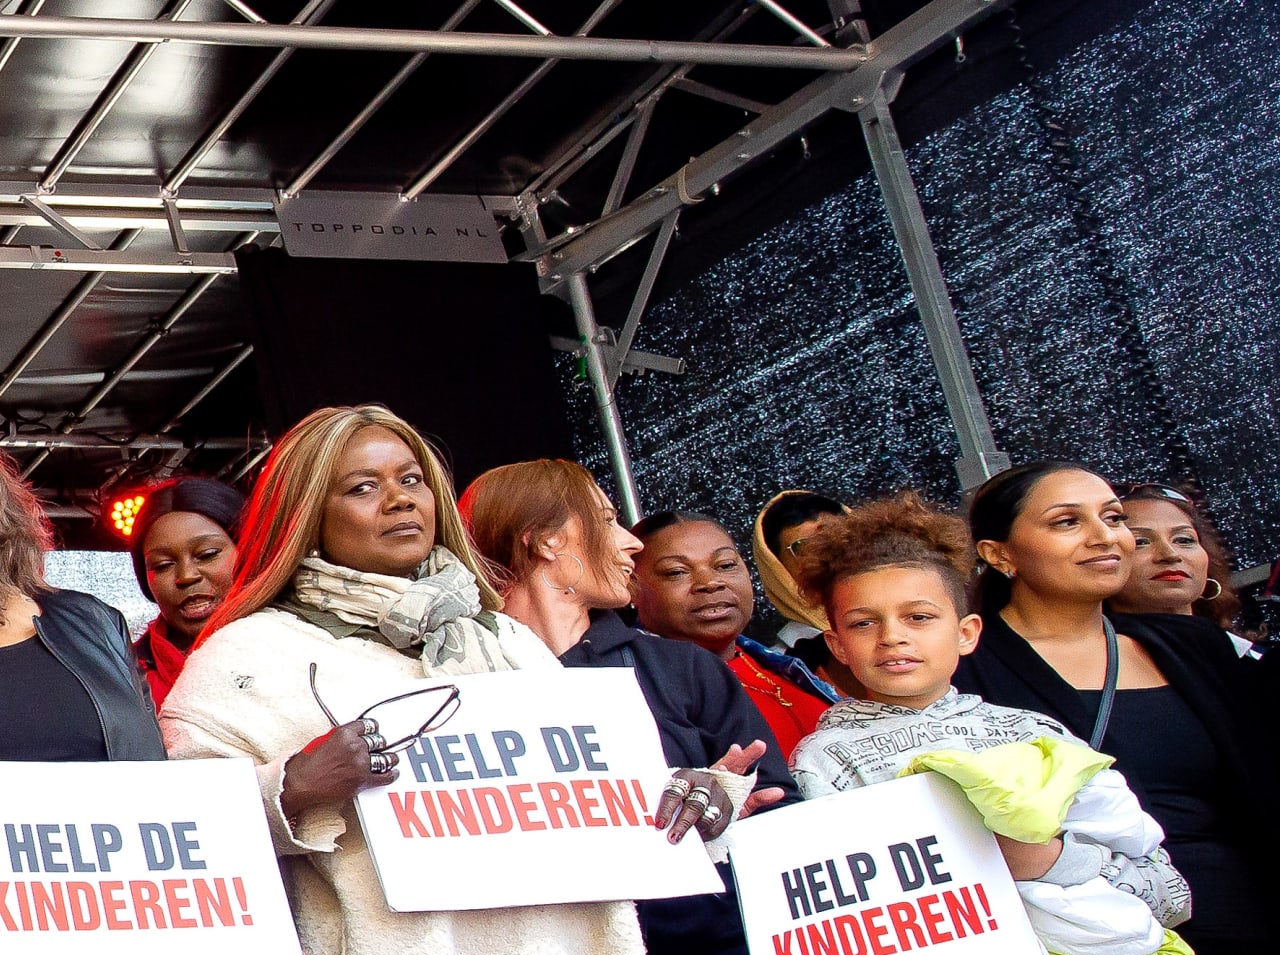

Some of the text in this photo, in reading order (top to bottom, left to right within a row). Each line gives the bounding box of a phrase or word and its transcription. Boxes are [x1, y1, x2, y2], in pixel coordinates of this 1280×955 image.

[292, 222, 487, 238] TOPPODIA NL
[406, 725, 608, 783] HELP DE
[944, 724, 1019, 738] COOL DAYS
[389, 779, 656, 838] KINDEREN!
[4, 822, 207, 872] HELP DE
[781, 835, 952, 920] HELP DE
